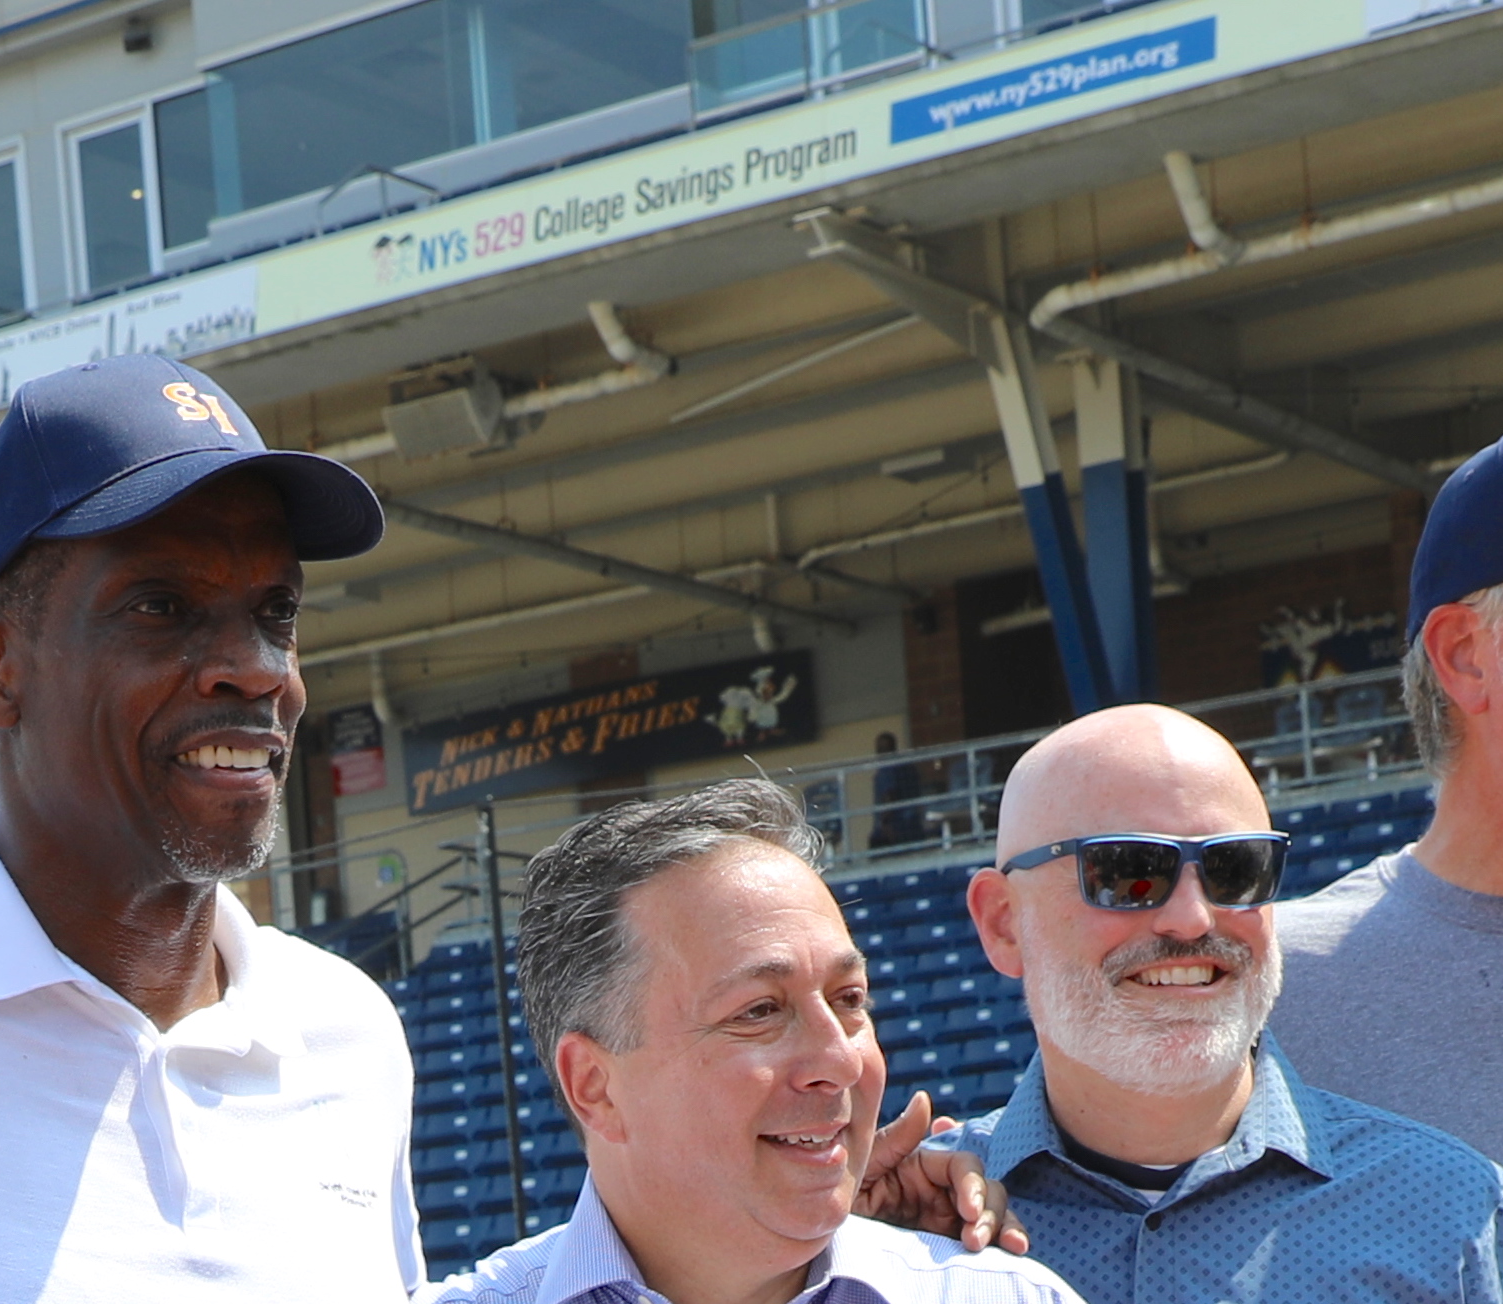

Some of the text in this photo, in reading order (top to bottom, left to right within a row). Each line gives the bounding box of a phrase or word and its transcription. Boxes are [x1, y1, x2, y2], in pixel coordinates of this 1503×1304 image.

[929, 40, 1180, 122] www.ny529plan.org
[473, 212, 526, 258] 529
[534, 189, 625, 242] College
[636, 166, 735, 214] Savings
[744, 128, 857, 186] Program
[162, 381, 239, 436] SI
[412, 696, 701, 808] TENDERS & FRIES
[440, 724, 497, 767] NICK
[506, 718, 527, 740] &
